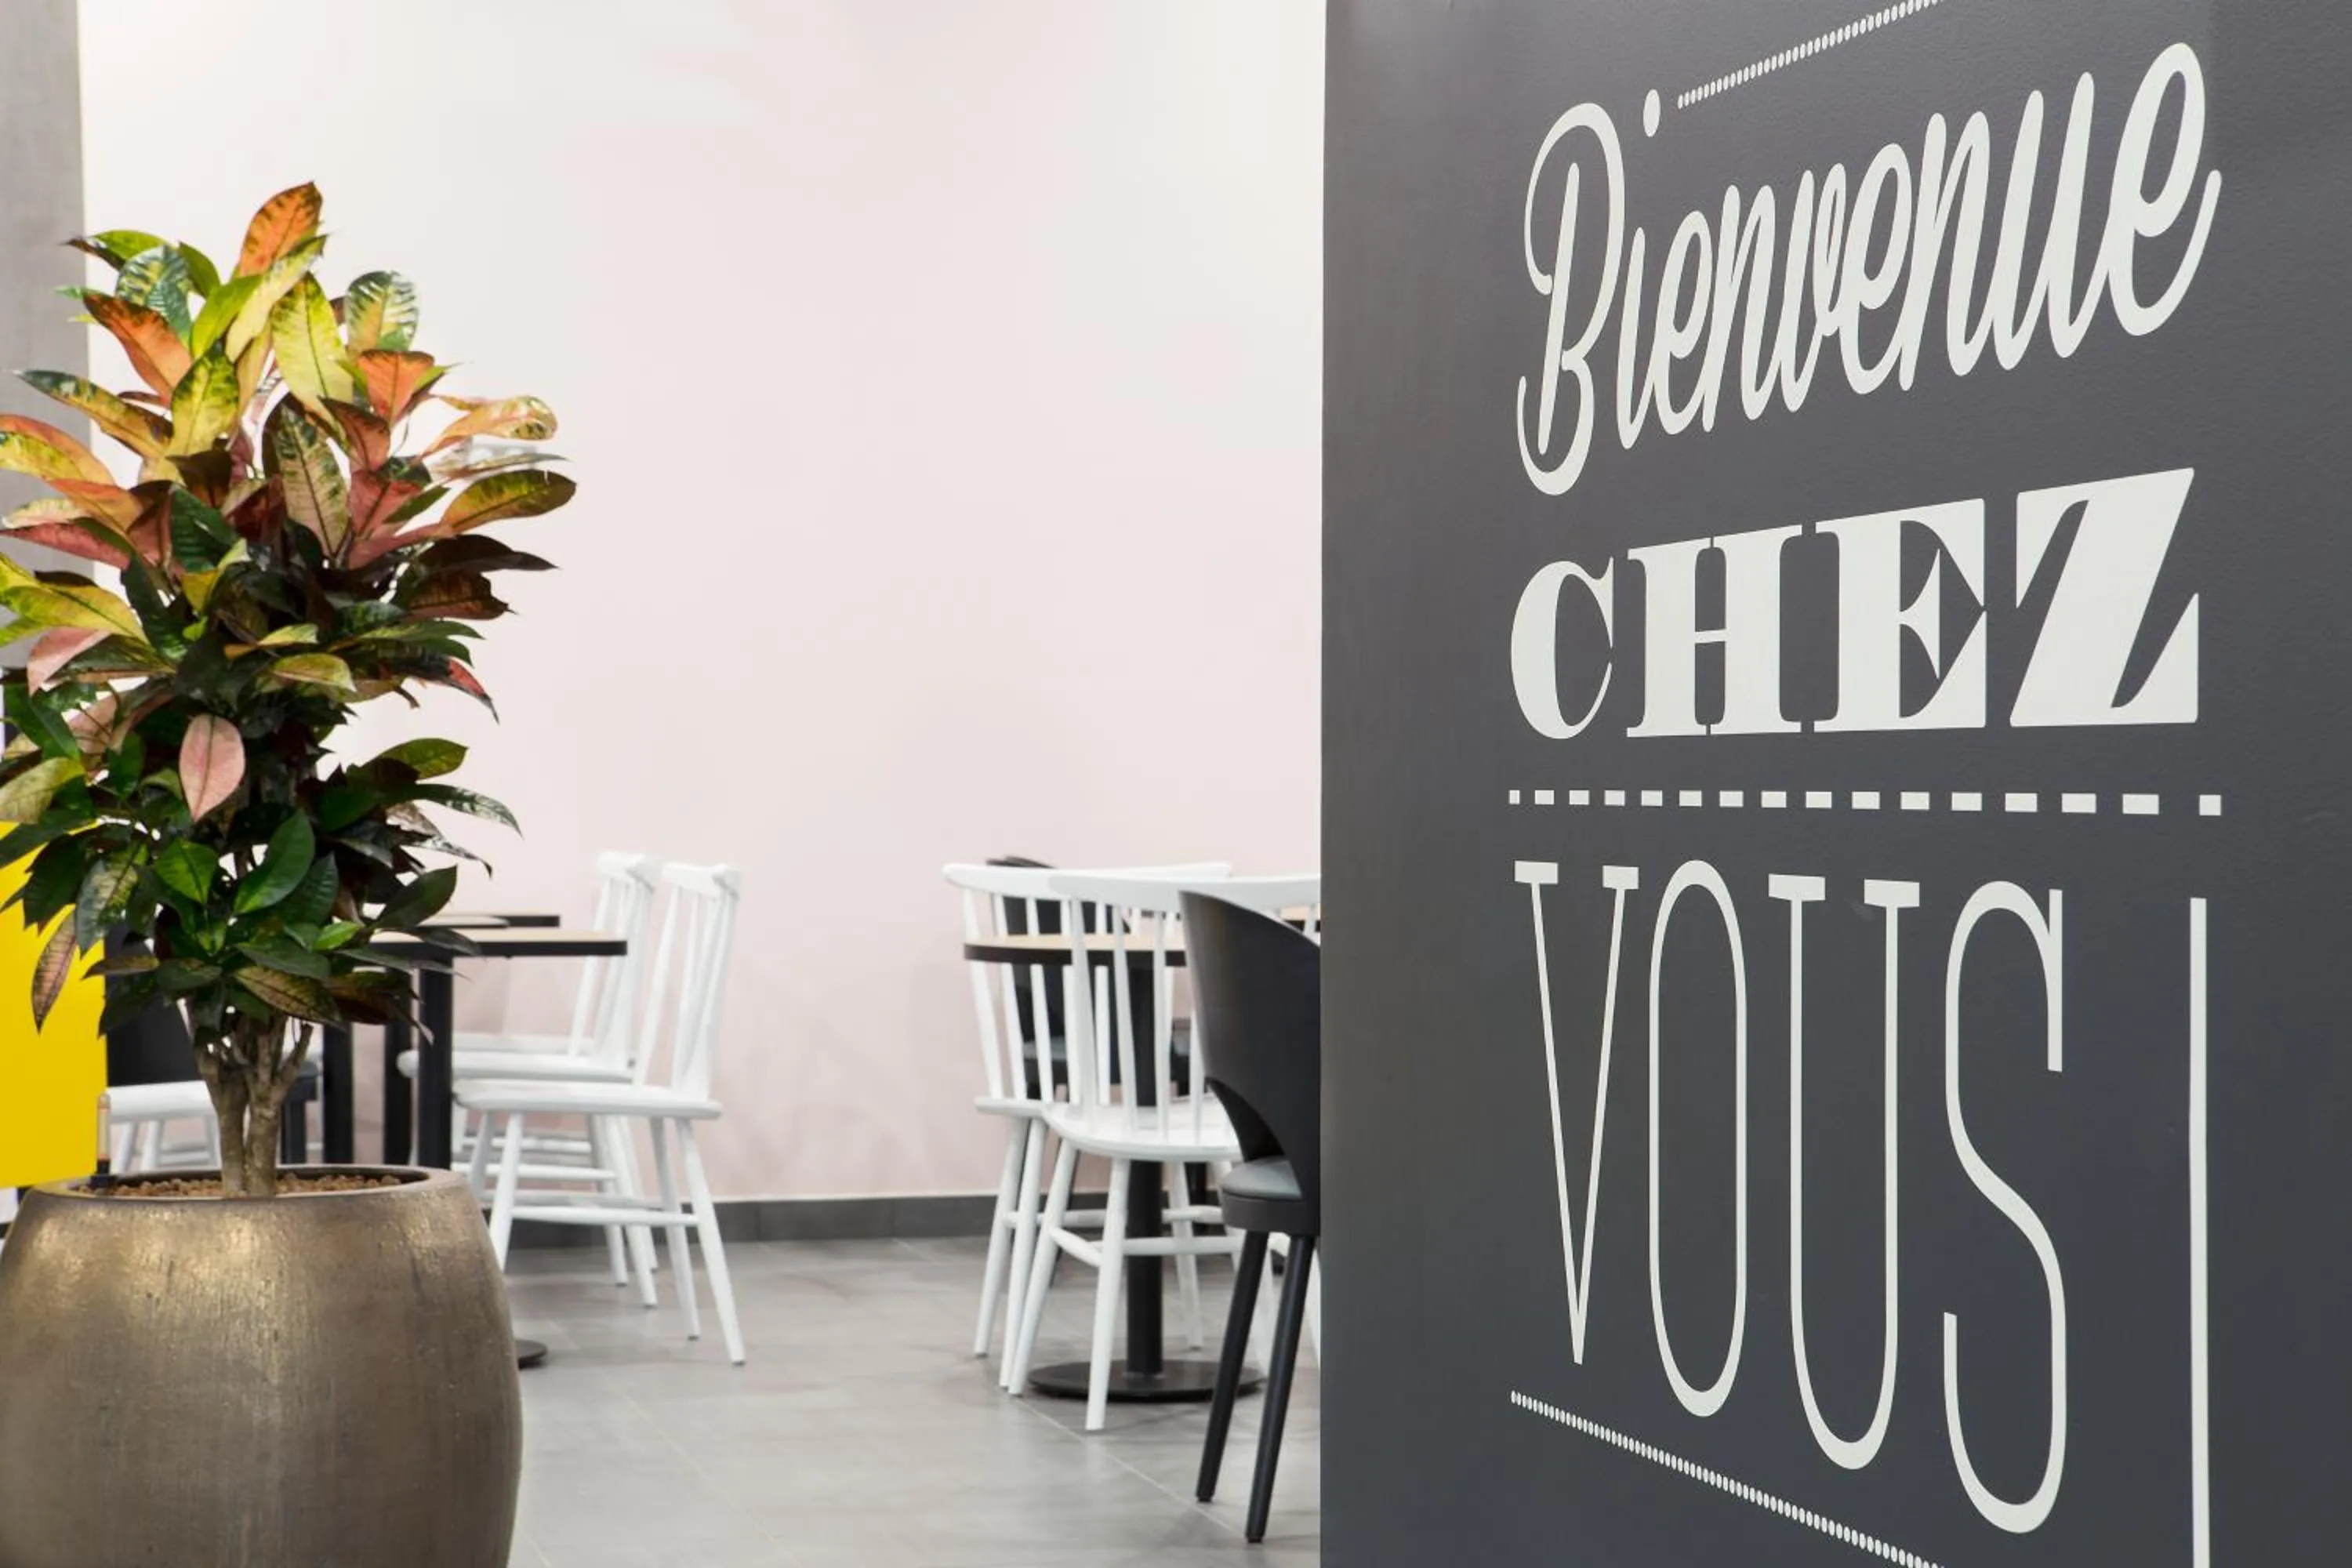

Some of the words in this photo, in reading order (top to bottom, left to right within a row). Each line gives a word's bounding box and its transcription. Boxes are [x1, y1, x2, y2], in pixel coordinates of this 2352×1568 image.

[1518, 43, 2221, 495] Bienvenue
[1511, 468, 2199, 739] CHEZ
[1514, 860, 2067, 1534] VOUS
